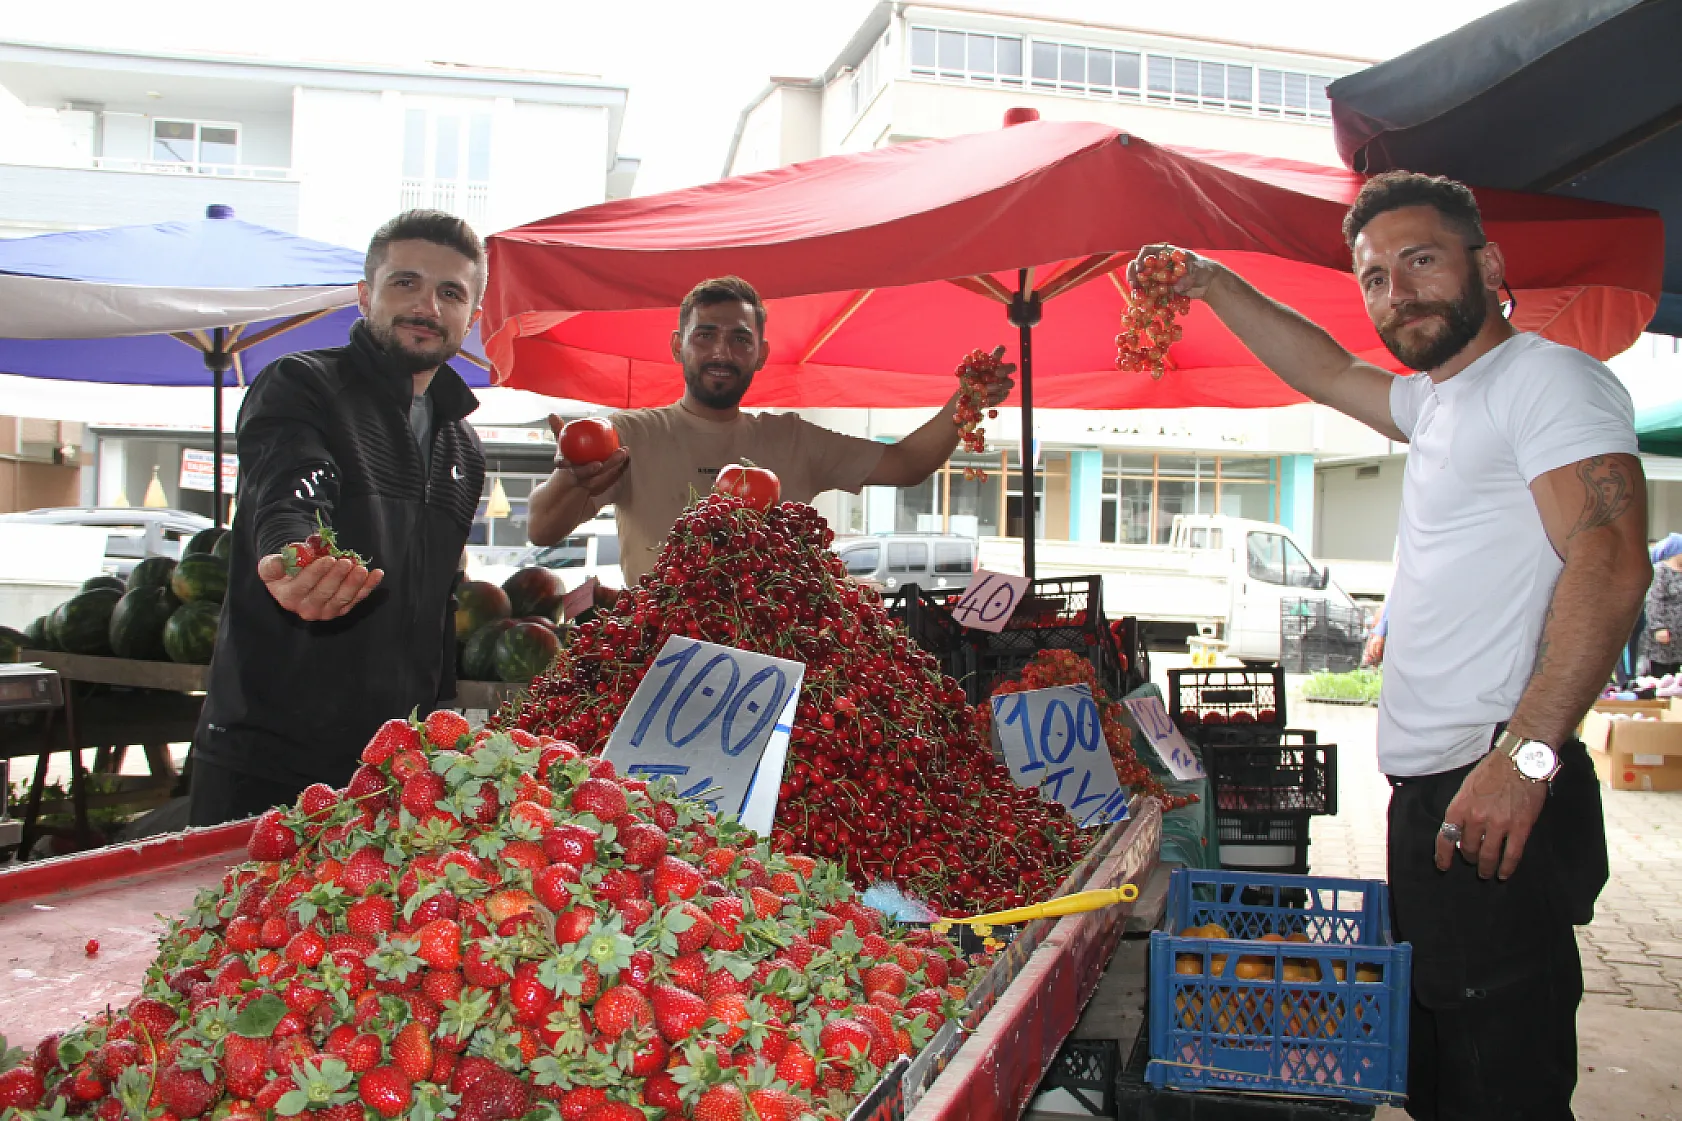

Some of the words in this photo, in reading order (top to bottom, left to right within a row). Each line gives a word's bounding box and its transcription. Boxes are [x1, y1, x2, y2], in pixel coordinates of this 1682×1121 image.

[957, 575, 1015, 622] 40
[630, 642, 787, 757] 100
[1004, 692, 1101, 773] 100
[1045, 767, 1106, 810] TL
